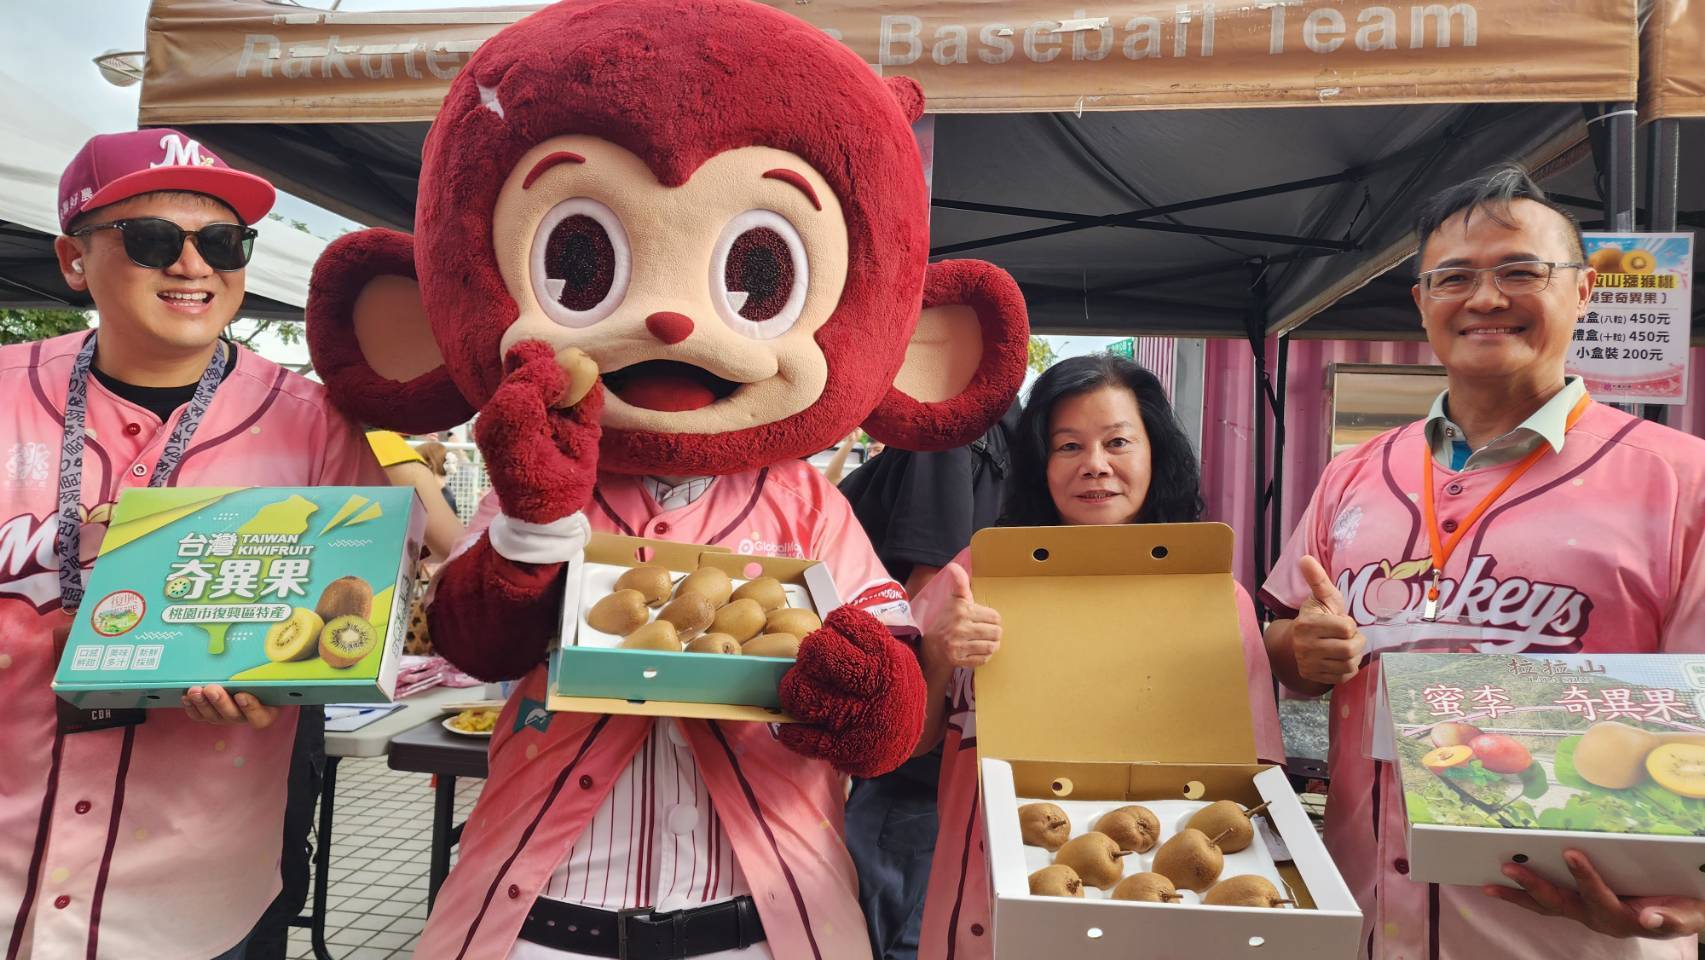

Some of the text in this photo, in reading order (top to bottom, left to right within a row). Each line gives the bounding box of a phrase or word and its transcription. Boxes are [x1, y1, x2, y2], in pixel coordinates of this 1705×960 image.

[235, 2, 1478, 80] Rakute Baseball Team
[150, 134, 201, 169] M
[1629, 313, 1671, 325] 450元
[1629, 331, 1670, 343] 450元
[1576, 347, 1663, 361] 小盒裝 200元
[177, 532, 237, 557] 台灣
[242, 534, 299, 544] TAIWAN
[237, 545, 314, 556] KIWIFRUIT
[165, 558, 311, 599] 奇異果
[1335, 552, 1590, 654] Monkeys
[168, 606, 286, 620] 桃園市復興區特產
[1508, 658, 1607, 676] 拉拉山
[1423, 684, 1515, 719] 蜜李
[1554, 685, 1699, 722] 奇異果
